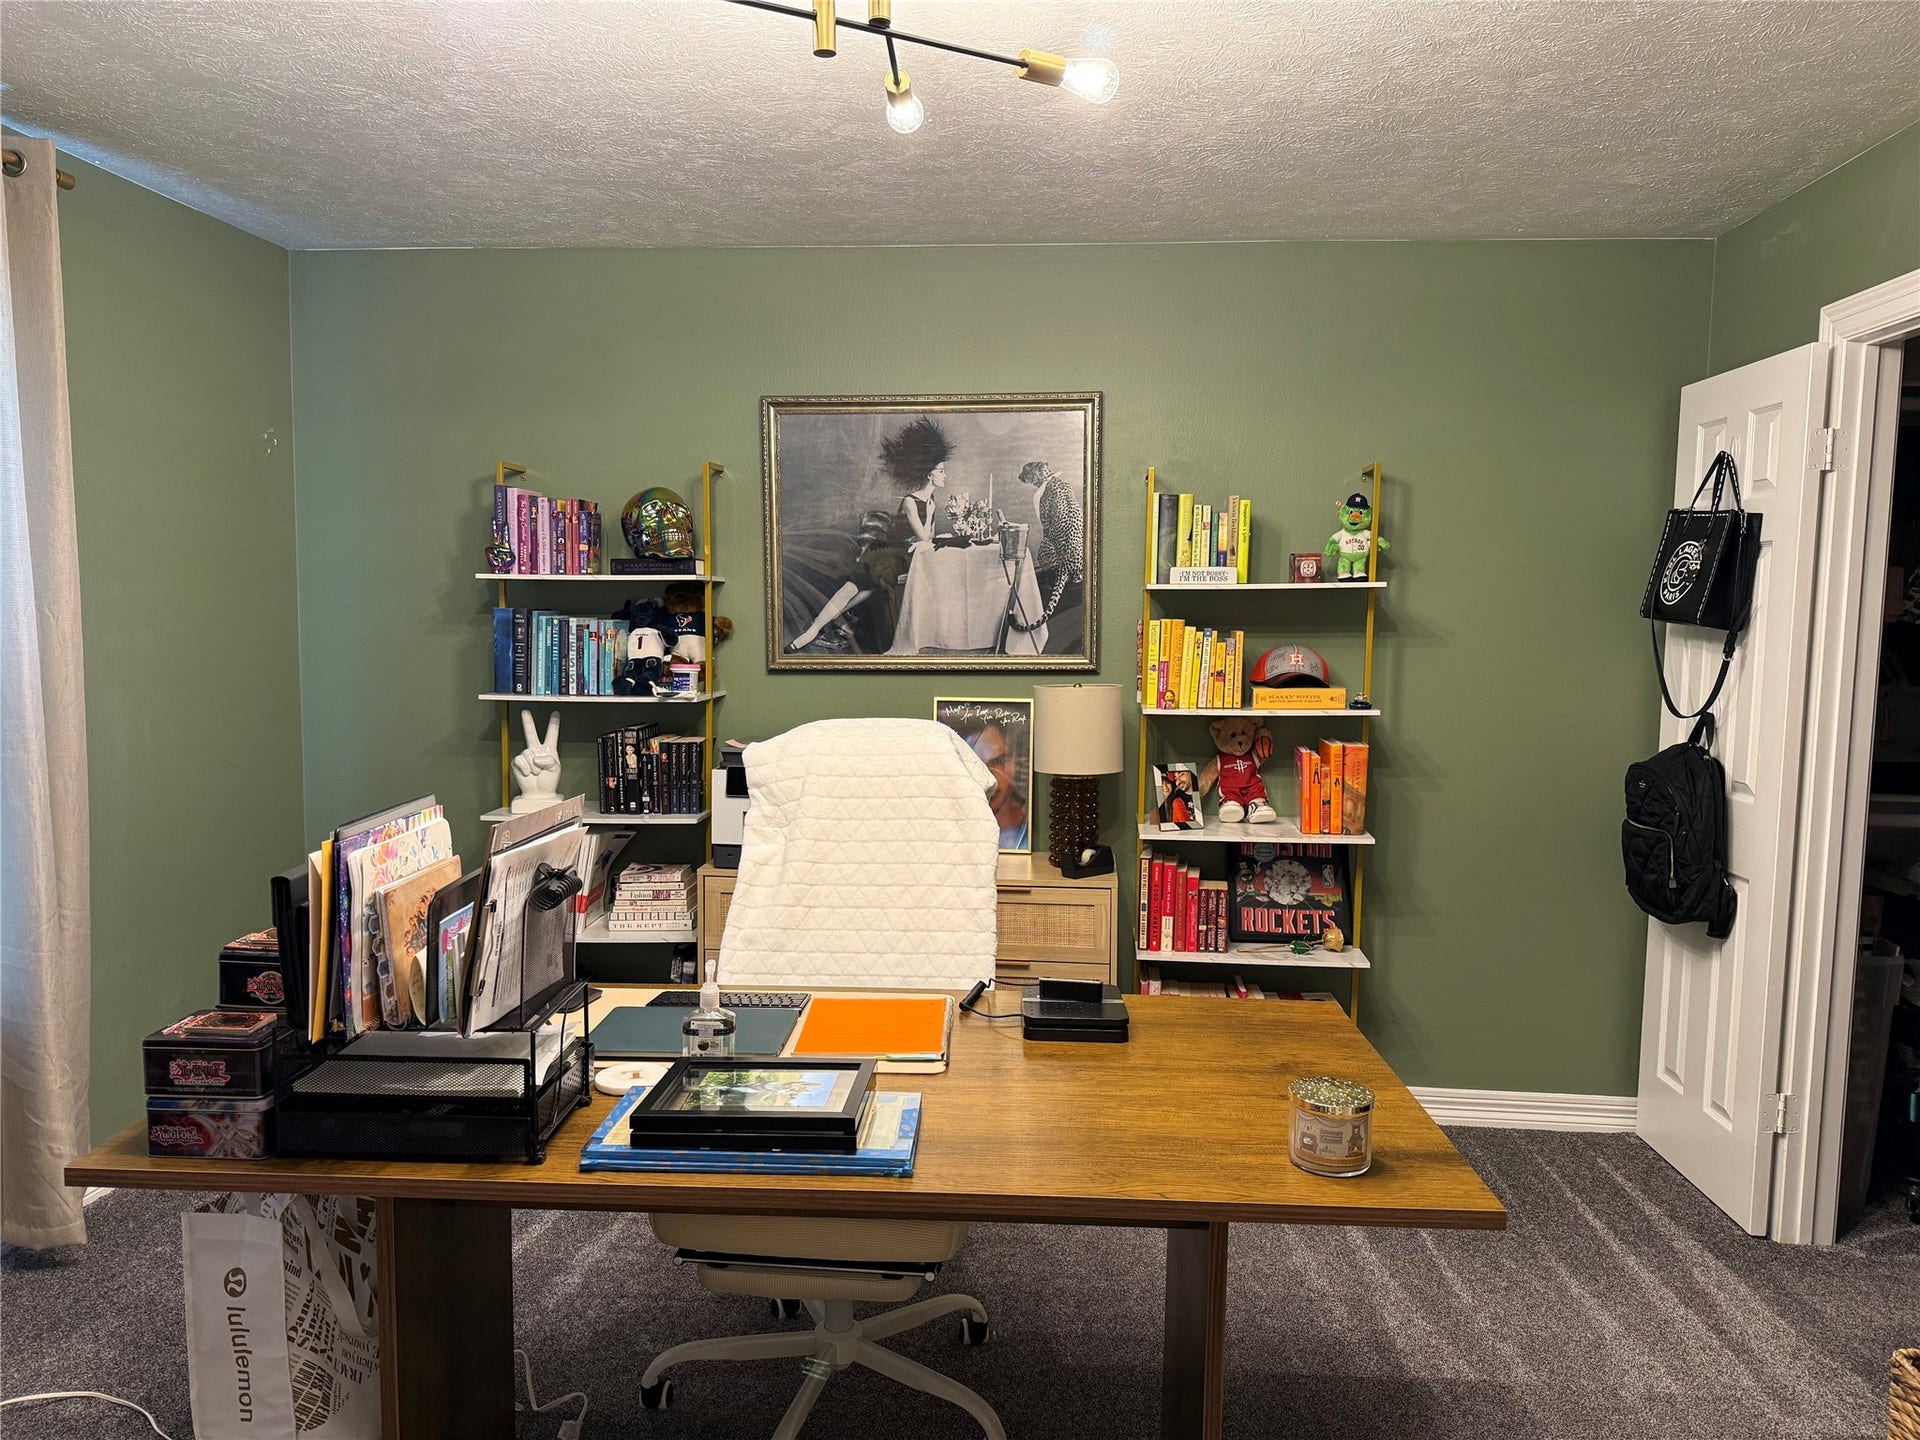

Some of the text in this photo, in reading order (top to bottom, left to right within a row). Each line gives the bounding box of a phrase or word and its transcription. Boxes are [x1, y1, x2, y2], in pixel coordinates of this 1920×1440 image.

[1663, 589, 1680, 601] PARIS
[1240, 843, 1333, 858] HUSTON
[630, 891, 652, 899] Fashion
[1153, 905, 1158, 914] TO
[1240, 906, 1336, 935] ROCKETS
[226, 1306, 254, 1423] lululemon
